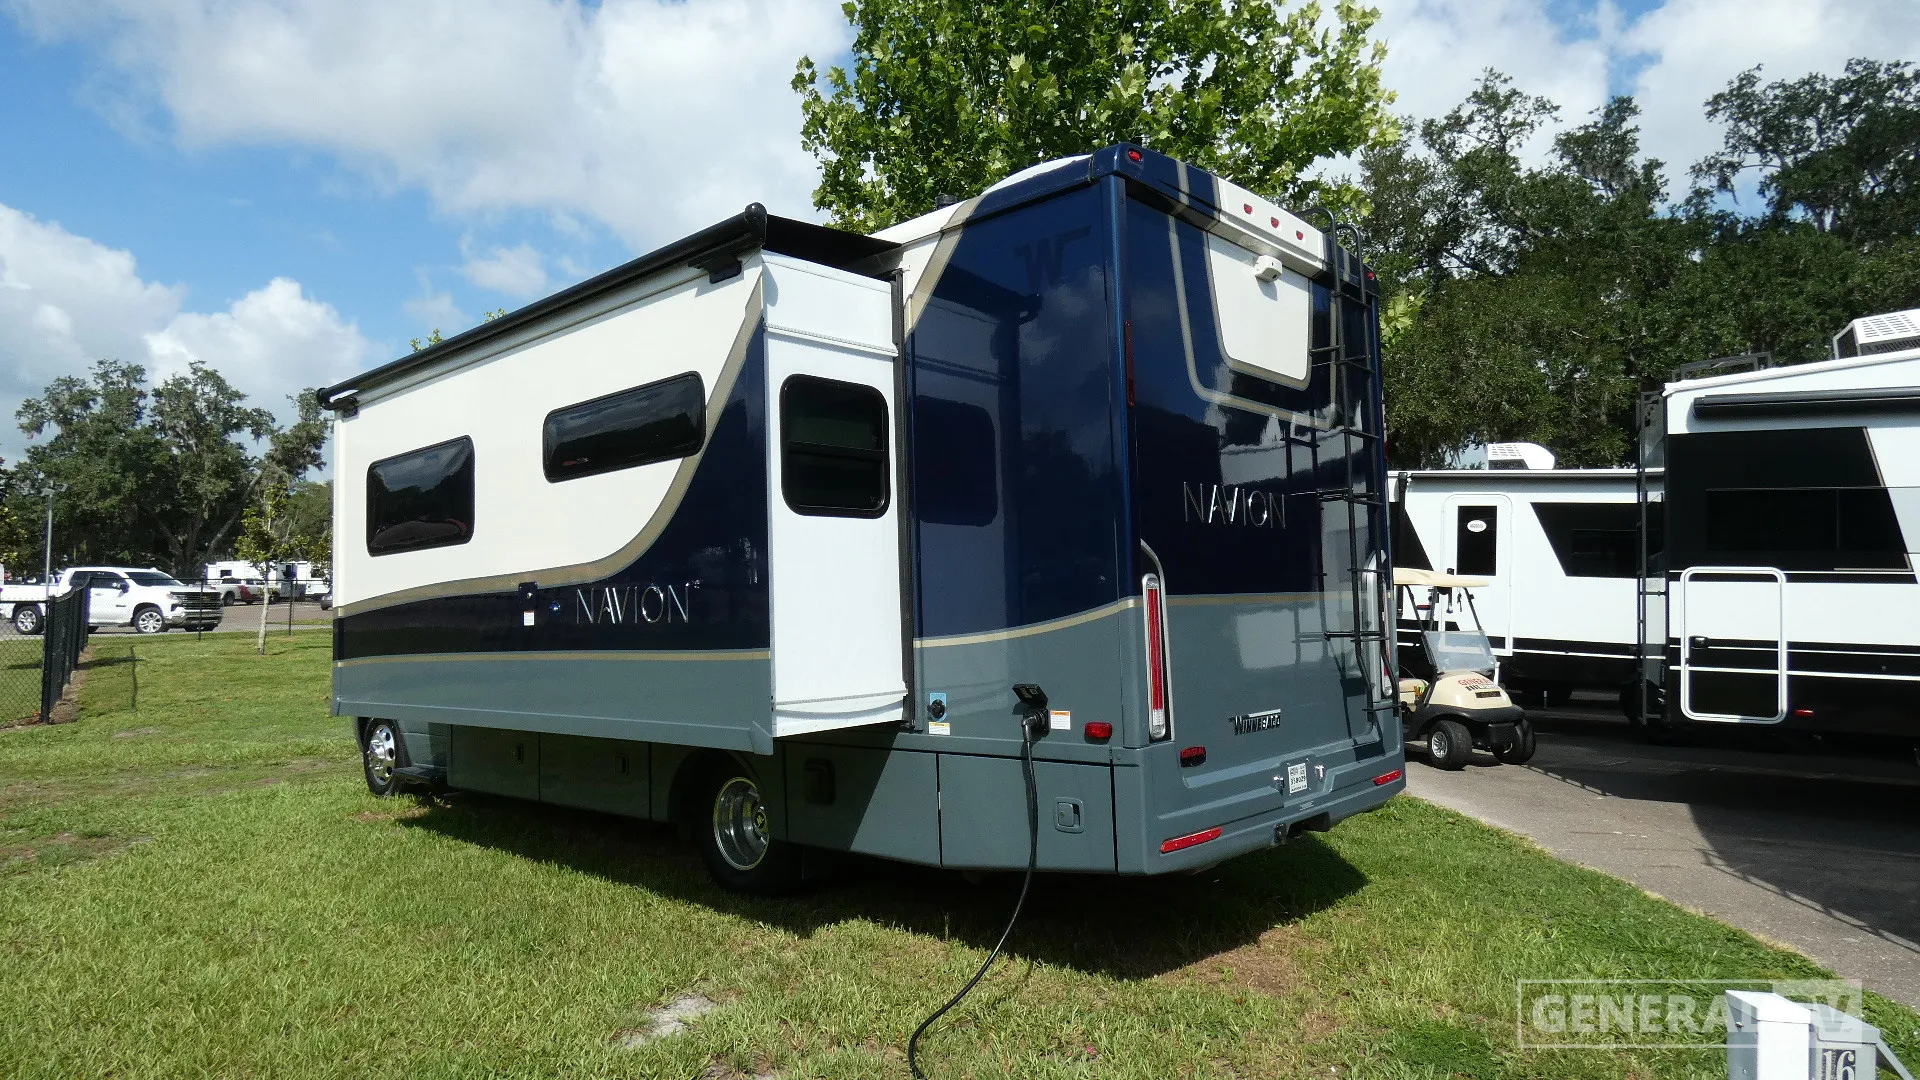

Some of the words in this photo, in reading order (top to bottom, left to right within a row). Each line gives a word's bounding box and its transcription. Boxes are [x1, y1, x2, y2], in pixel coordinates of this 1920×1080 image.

[1183, 481, 1287, 529] NAVION
[576, 584, 689, 624] NAVION
[1823, 1050, 1855, 1080] 16
